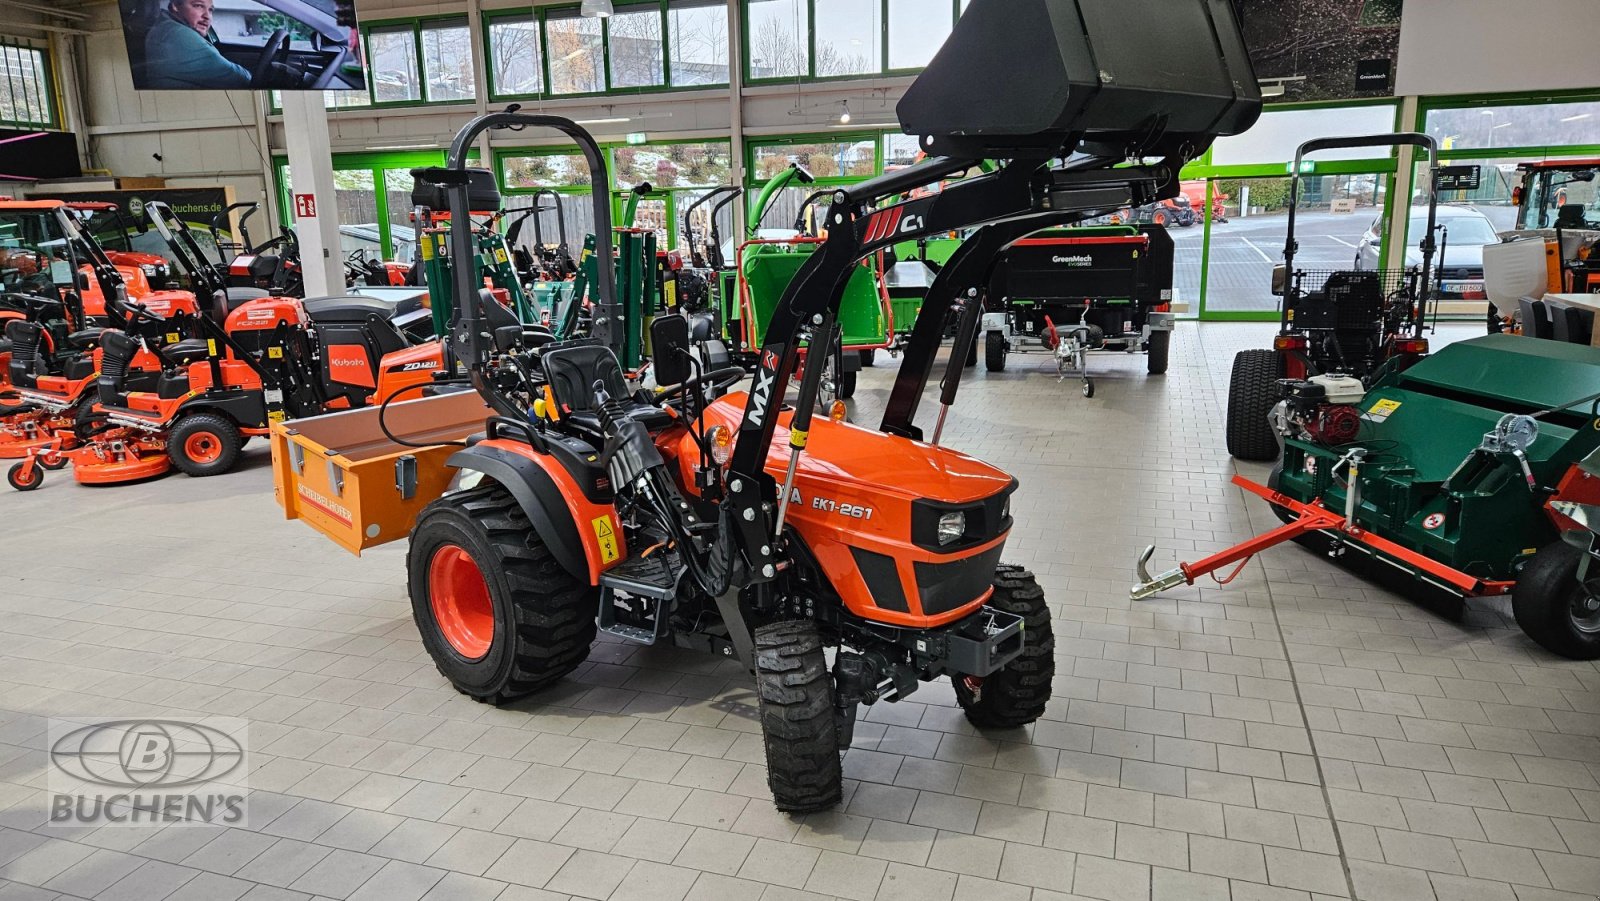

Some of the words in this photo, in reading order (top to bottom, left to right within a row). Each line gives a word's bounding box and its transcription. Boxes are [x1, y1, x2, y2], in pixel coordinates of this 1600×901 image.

[172, 203, 221, 212] buchens.de
[901, 214, 924, 232] C1
[1052, 254, 1092, 262] GreenMech
[748, 367, 774, 427] MX
[812, 497, 873, 520] EK1-261
